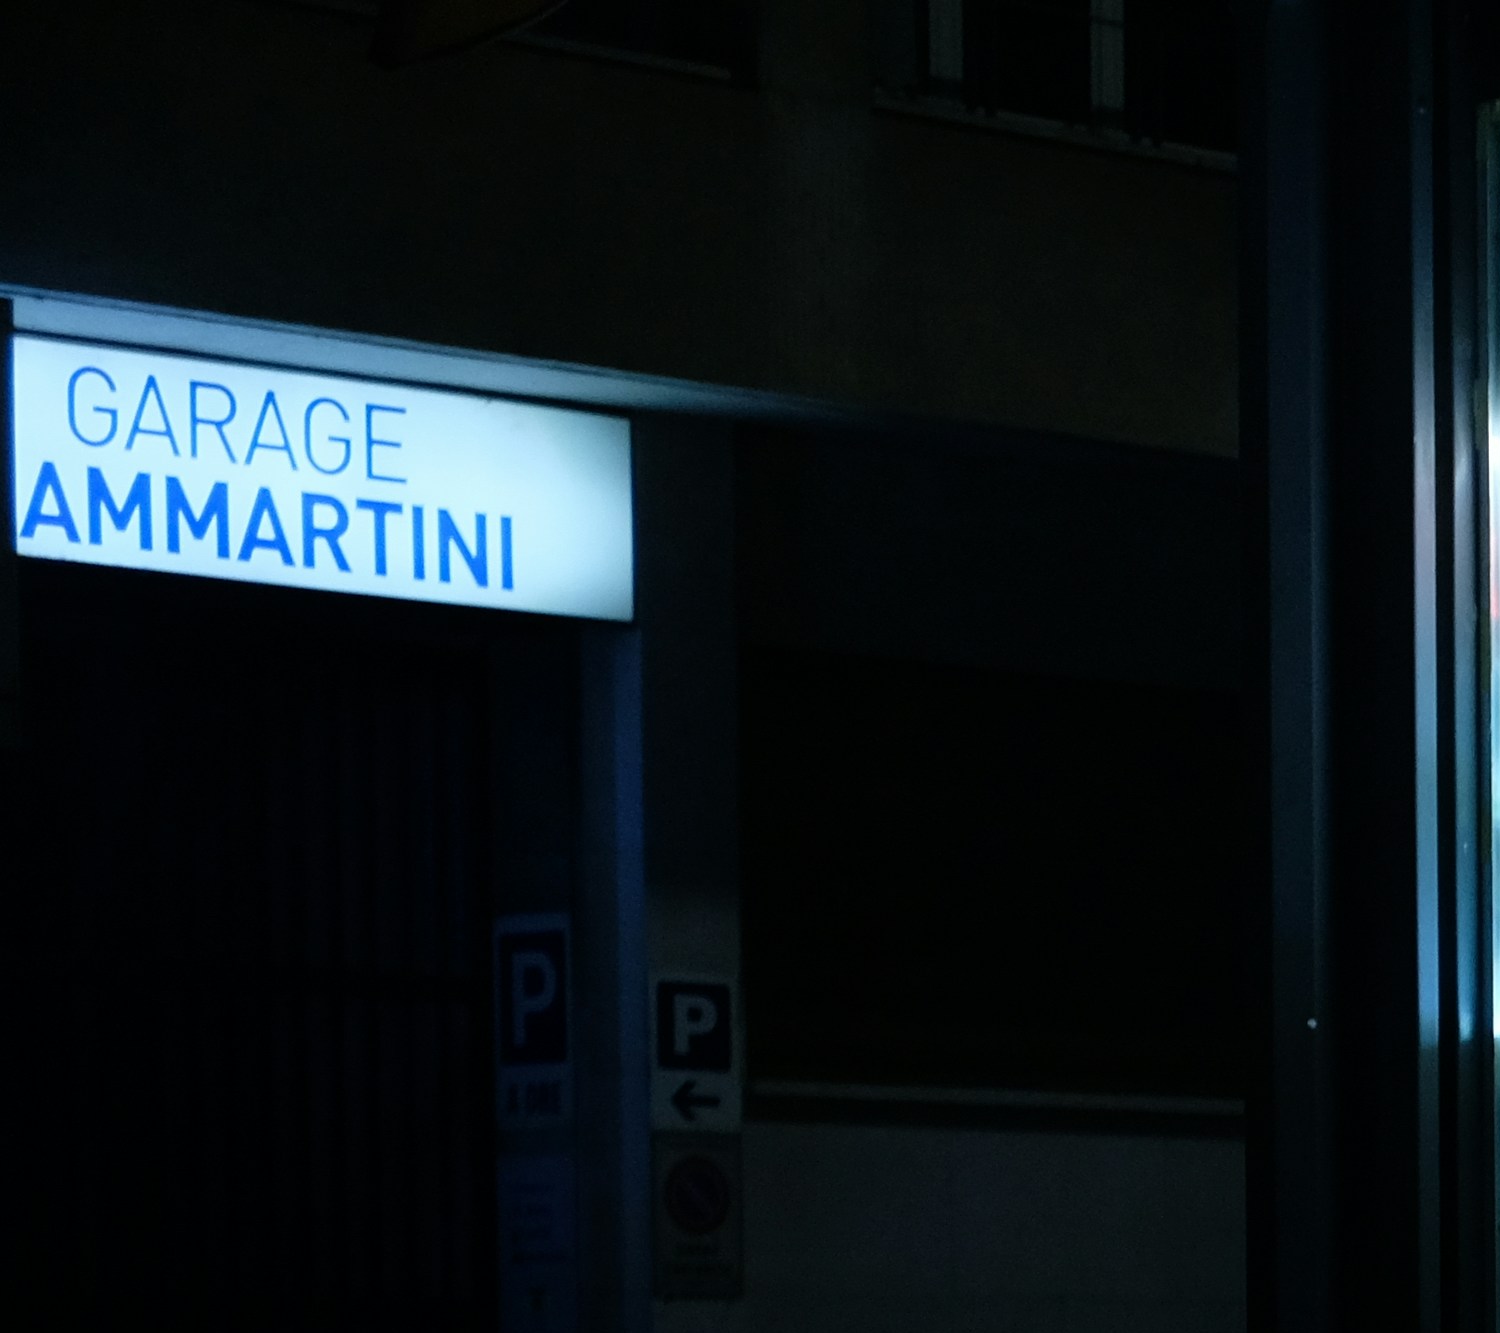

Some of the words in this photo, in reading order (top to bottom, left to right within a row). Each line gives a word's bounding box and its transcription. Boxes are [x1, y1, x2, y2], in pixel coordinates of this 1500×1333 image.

[66, 366, 408, 484] GARAGE
[19, 460, 516, 592] AMMARTINI
[510, 947, 558, 1048] P
[671, 991, 718, 1057] P
